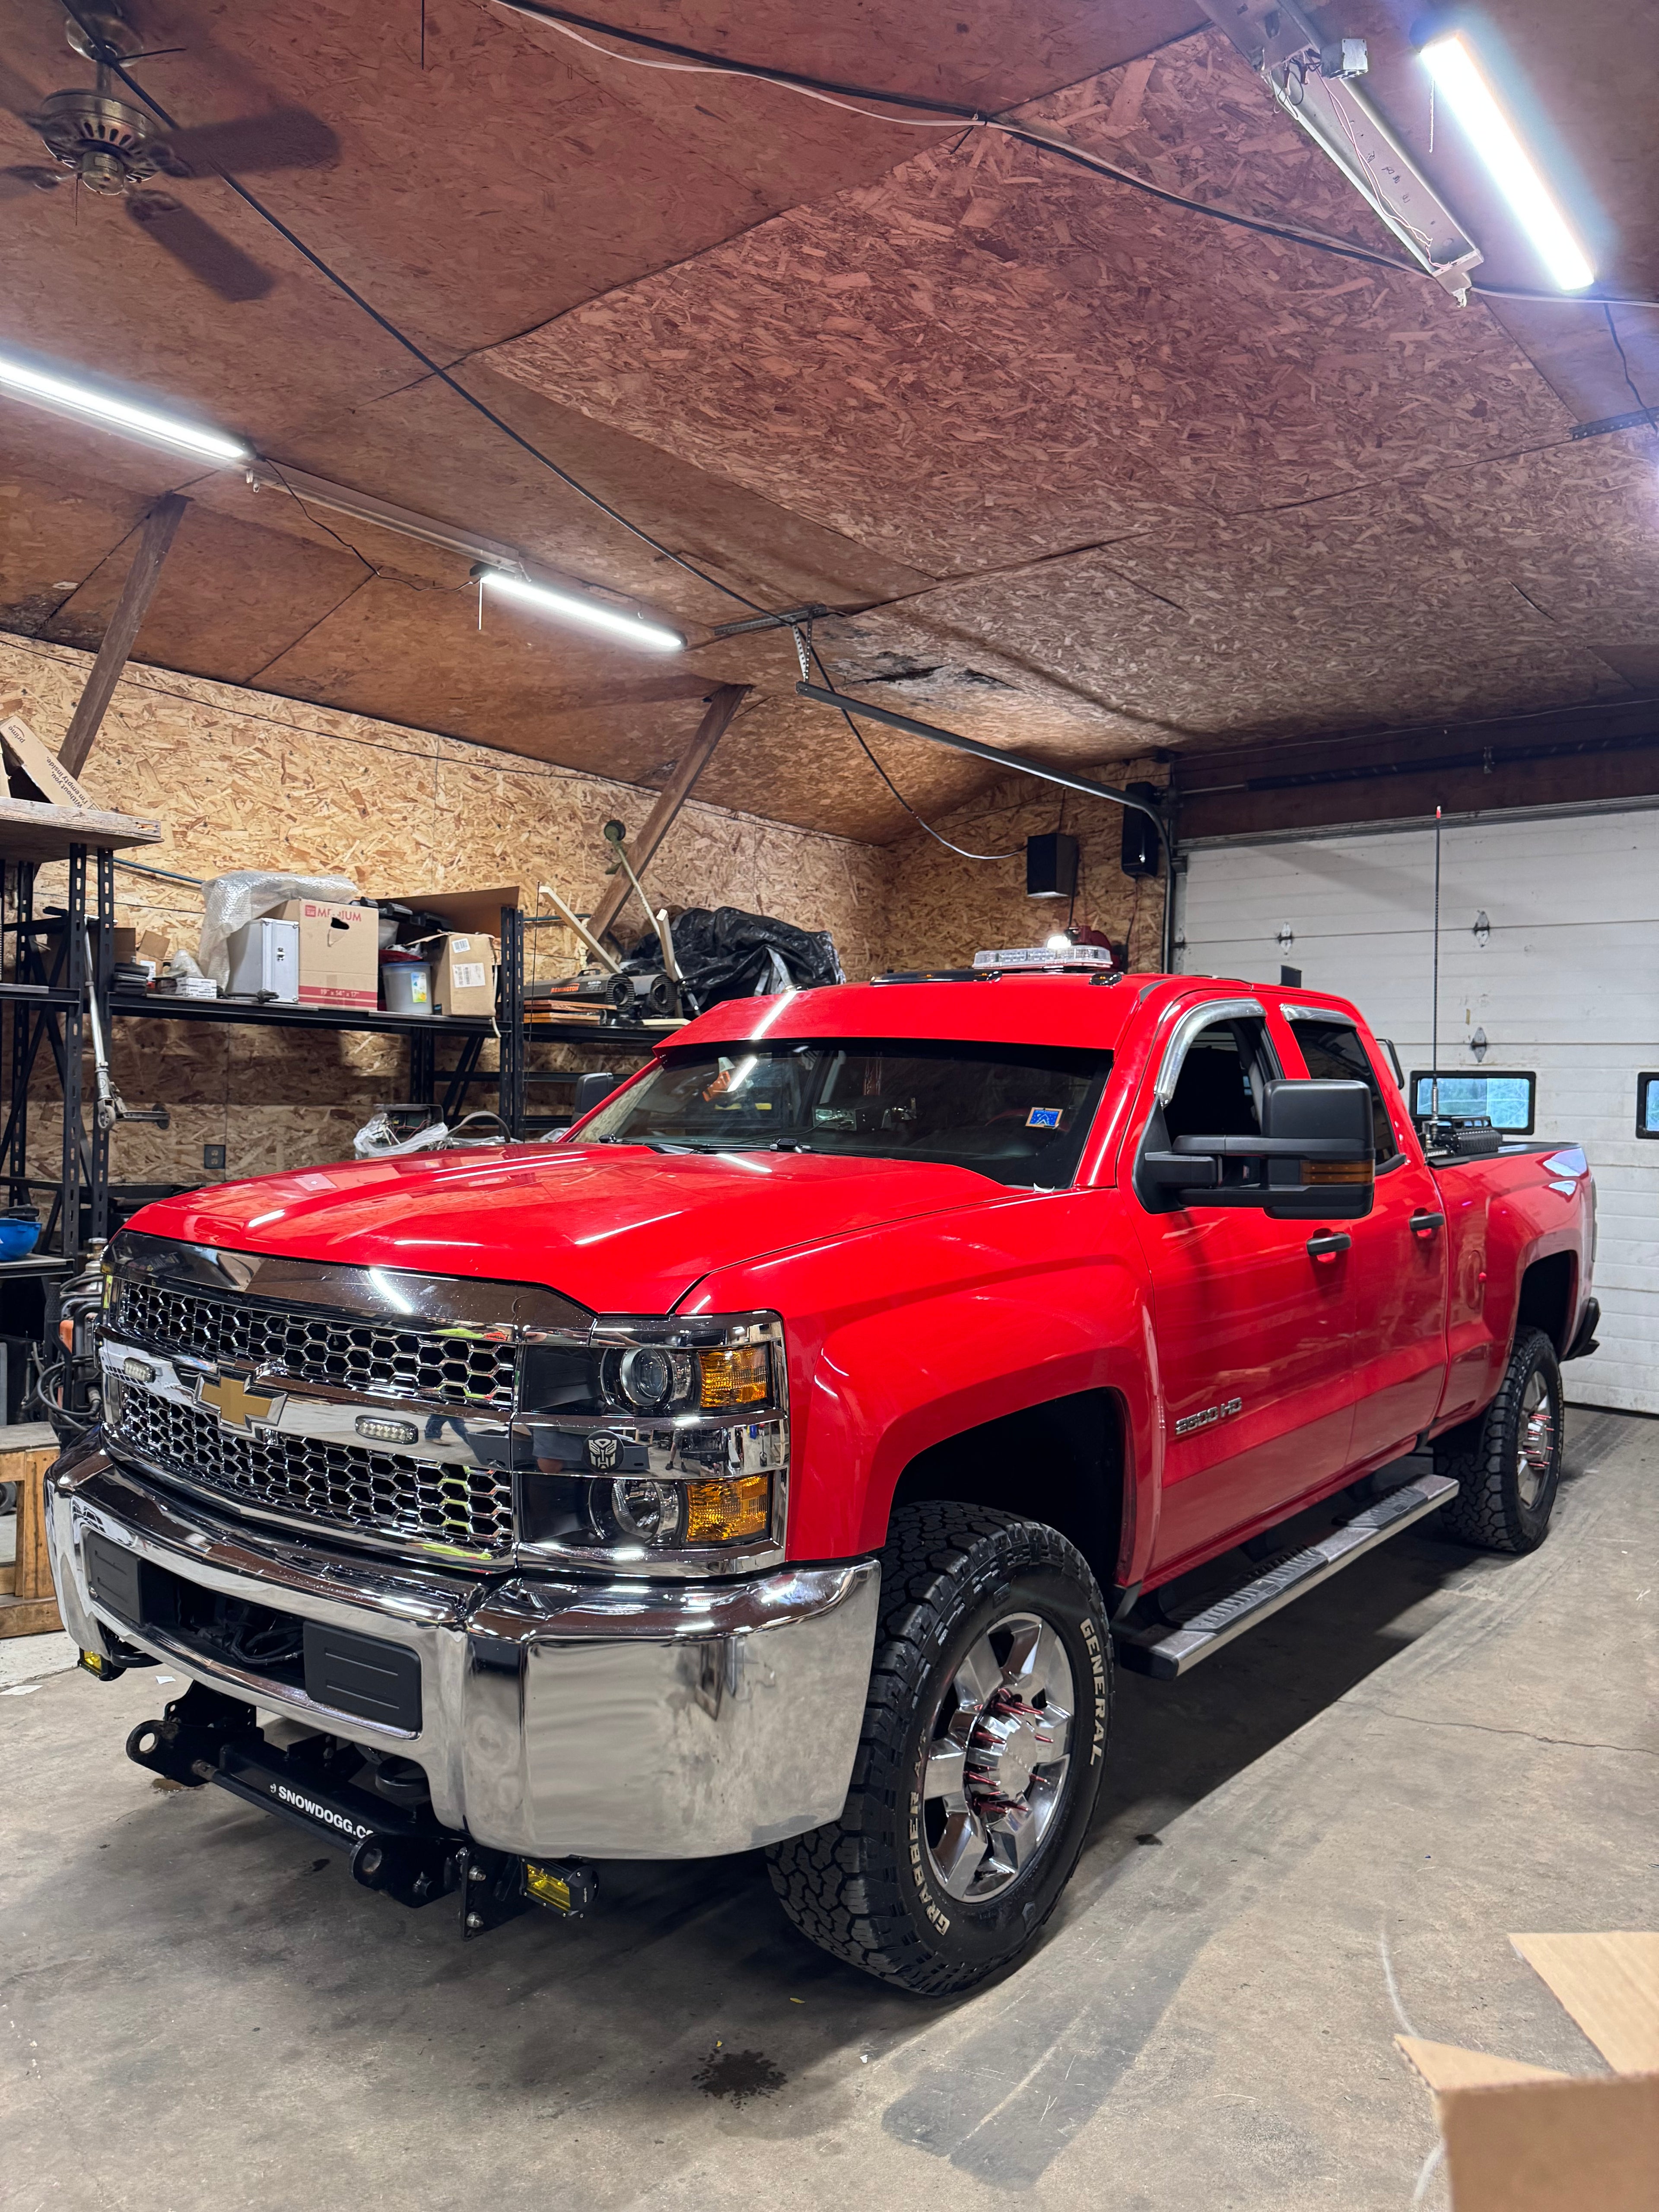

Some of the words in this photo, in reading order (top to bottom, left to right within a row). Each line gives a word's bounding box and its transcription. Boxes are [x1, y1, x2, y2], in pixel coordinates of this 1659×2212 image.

[8, 726, 25, 743] prime
[46, 756, 64, 778] inside.
[62, 775, 80, 795] empty
[1175, 1406, 1218, 1435] 2500
[1220, 1397, 1242, 1418] HD
[1080, 1618, 1106, 1766] GENERAL
[909, 1791, 950, 1936] GRABBER
